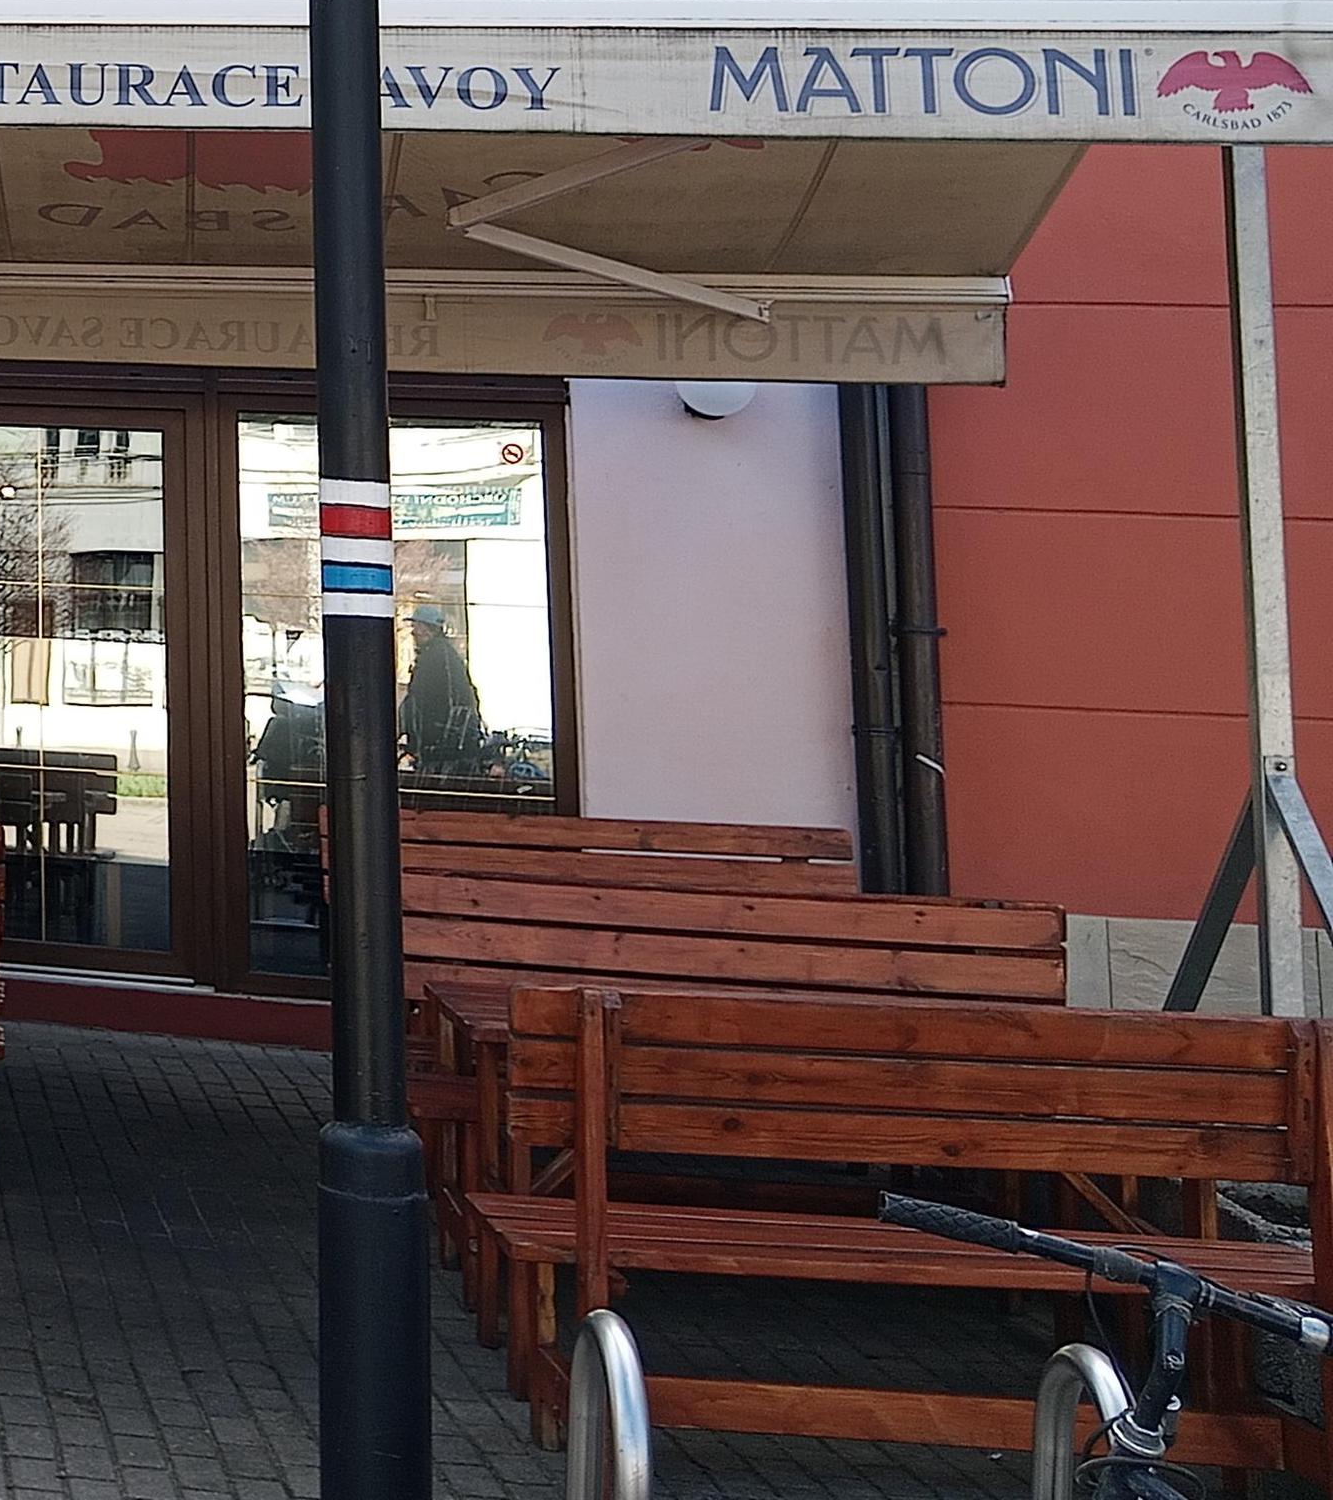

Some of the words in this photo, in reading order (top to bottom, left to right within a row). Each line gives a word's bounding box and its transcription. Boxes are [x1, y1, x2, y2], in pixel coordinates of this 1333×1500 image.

[380, 65, 562, 110] AVOY
[709, 46, 1137, 118] MATTONI
[1183, 102, 1262, 131] CARLSBAD
[1267, 100, 1293, 124] 1873
